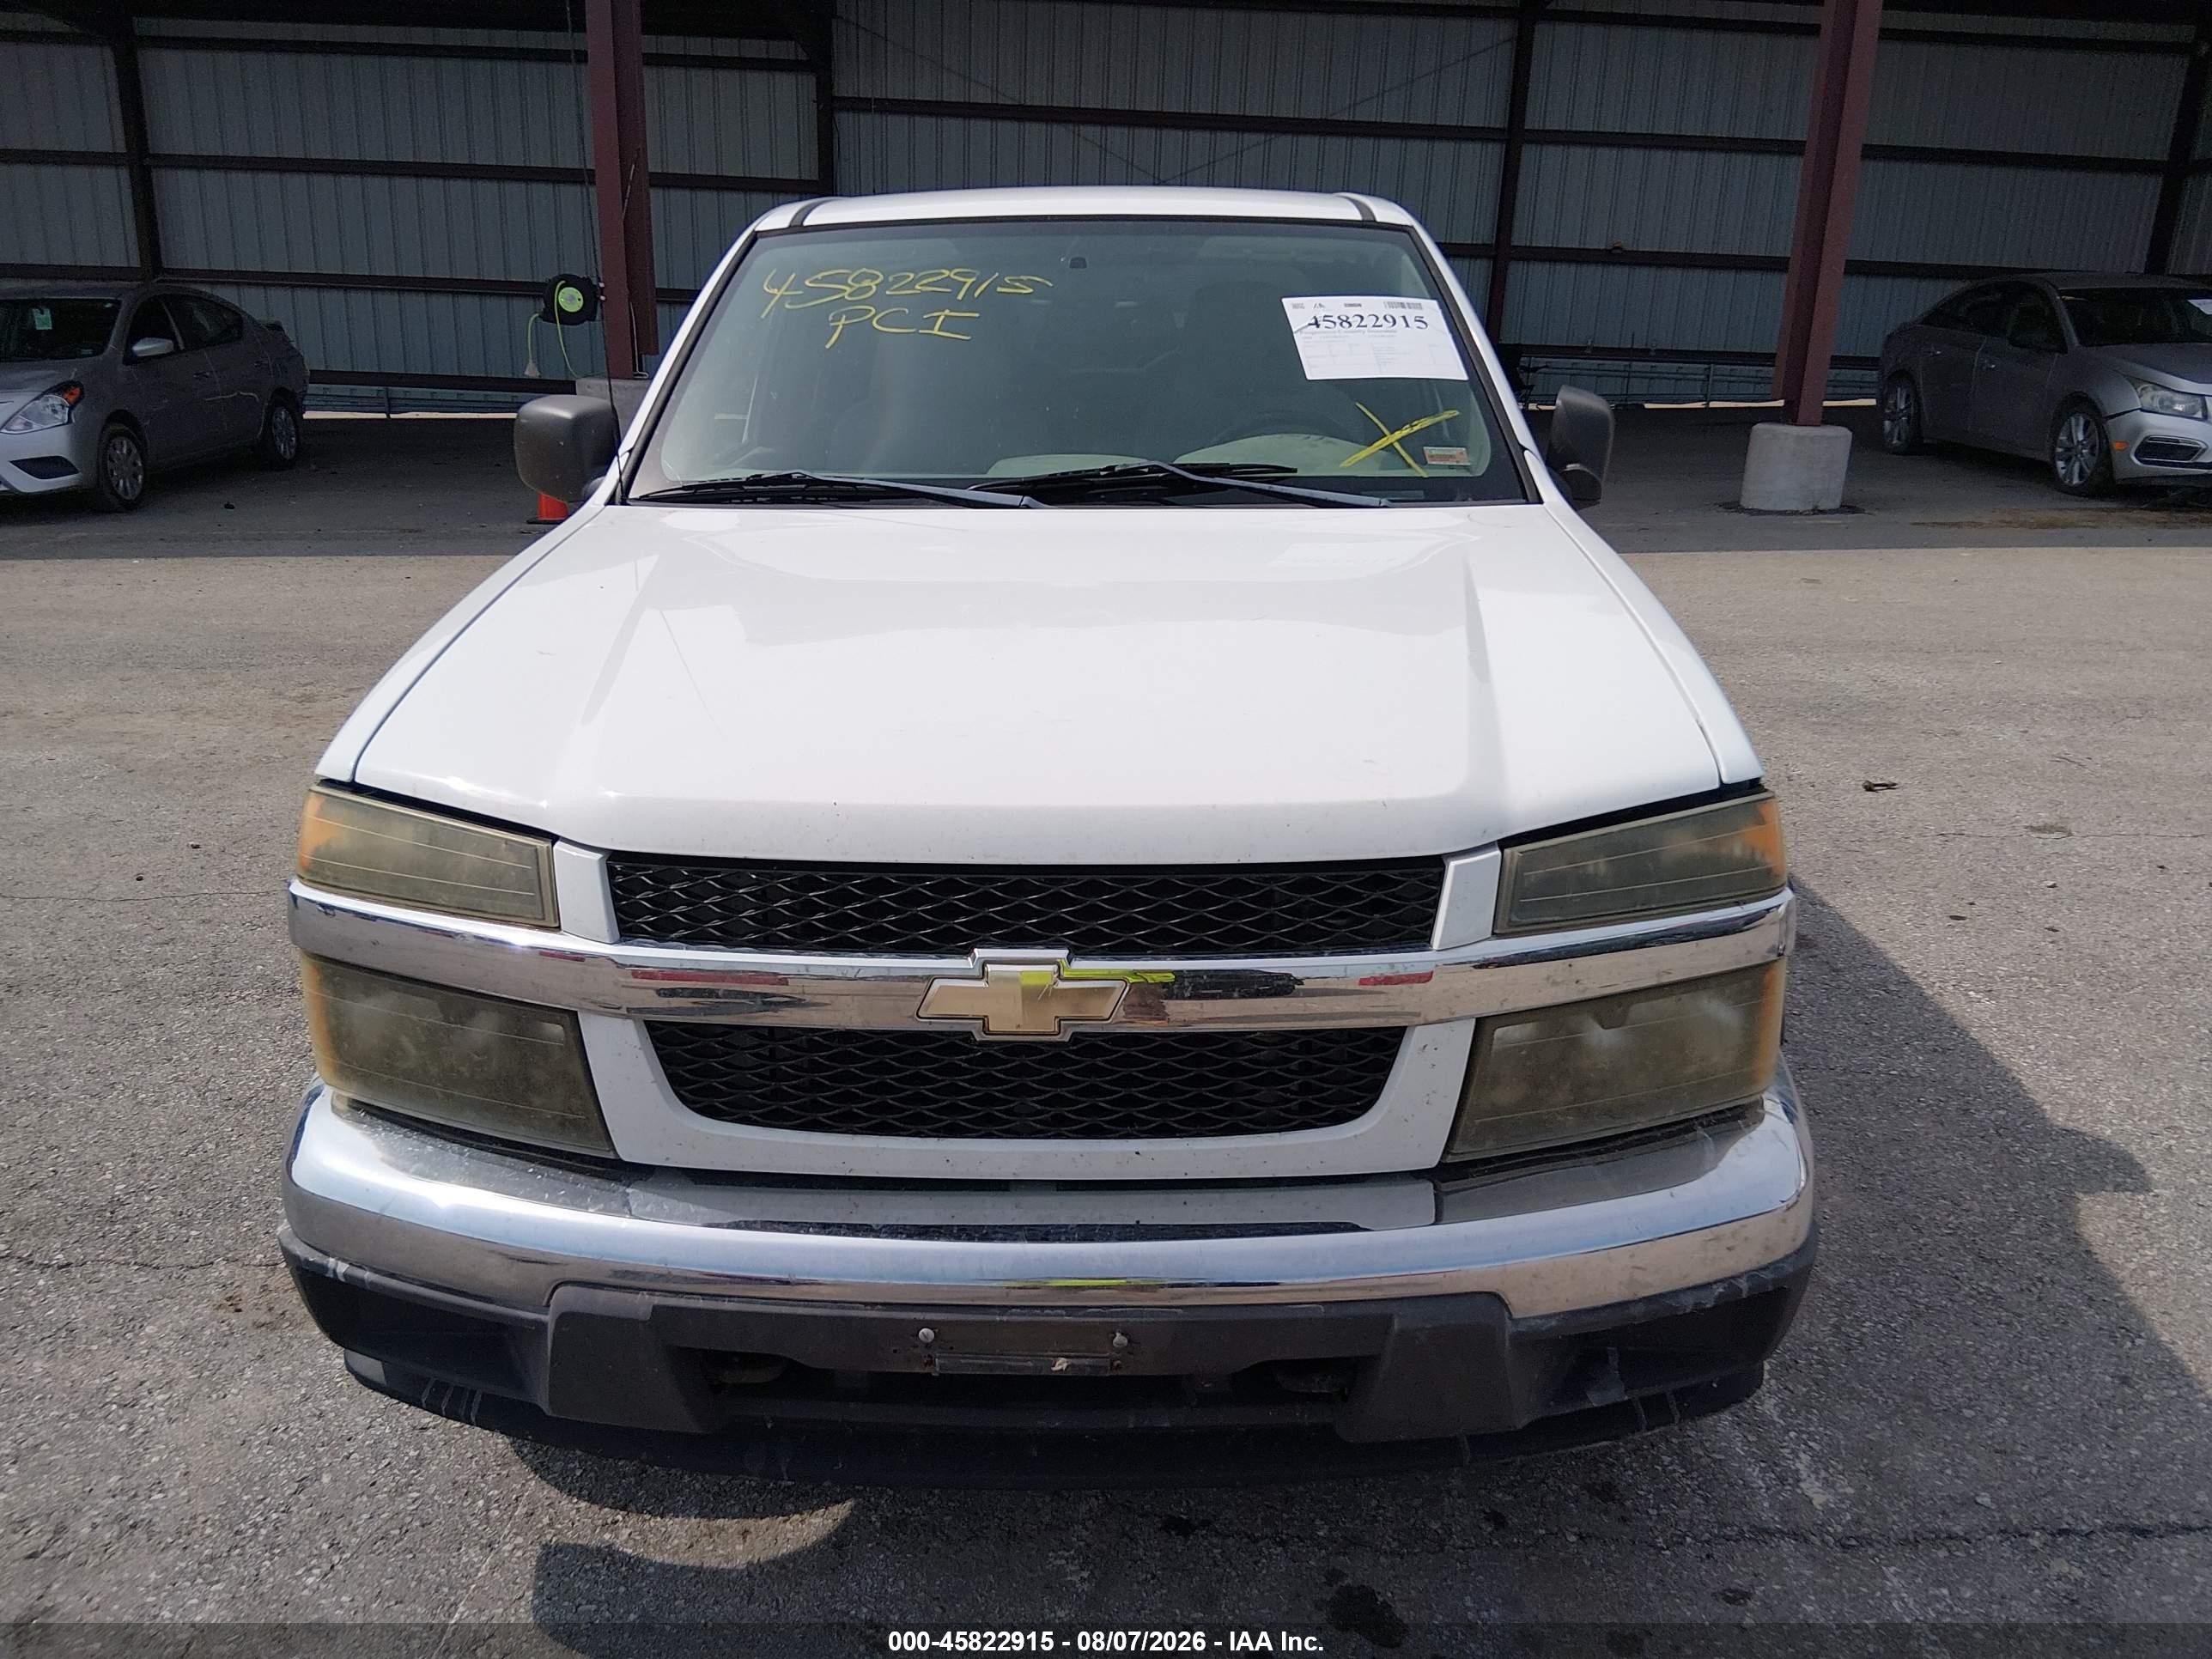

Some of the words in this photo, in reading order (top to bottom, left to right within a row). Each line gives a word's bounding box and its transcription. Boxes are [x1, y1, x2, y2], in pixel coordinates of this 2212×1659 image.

[761, 267, 1054, 319] 45822915
[824, 304, 981, 349] PCI
[1308, 313, 1429, 330] 45822915
